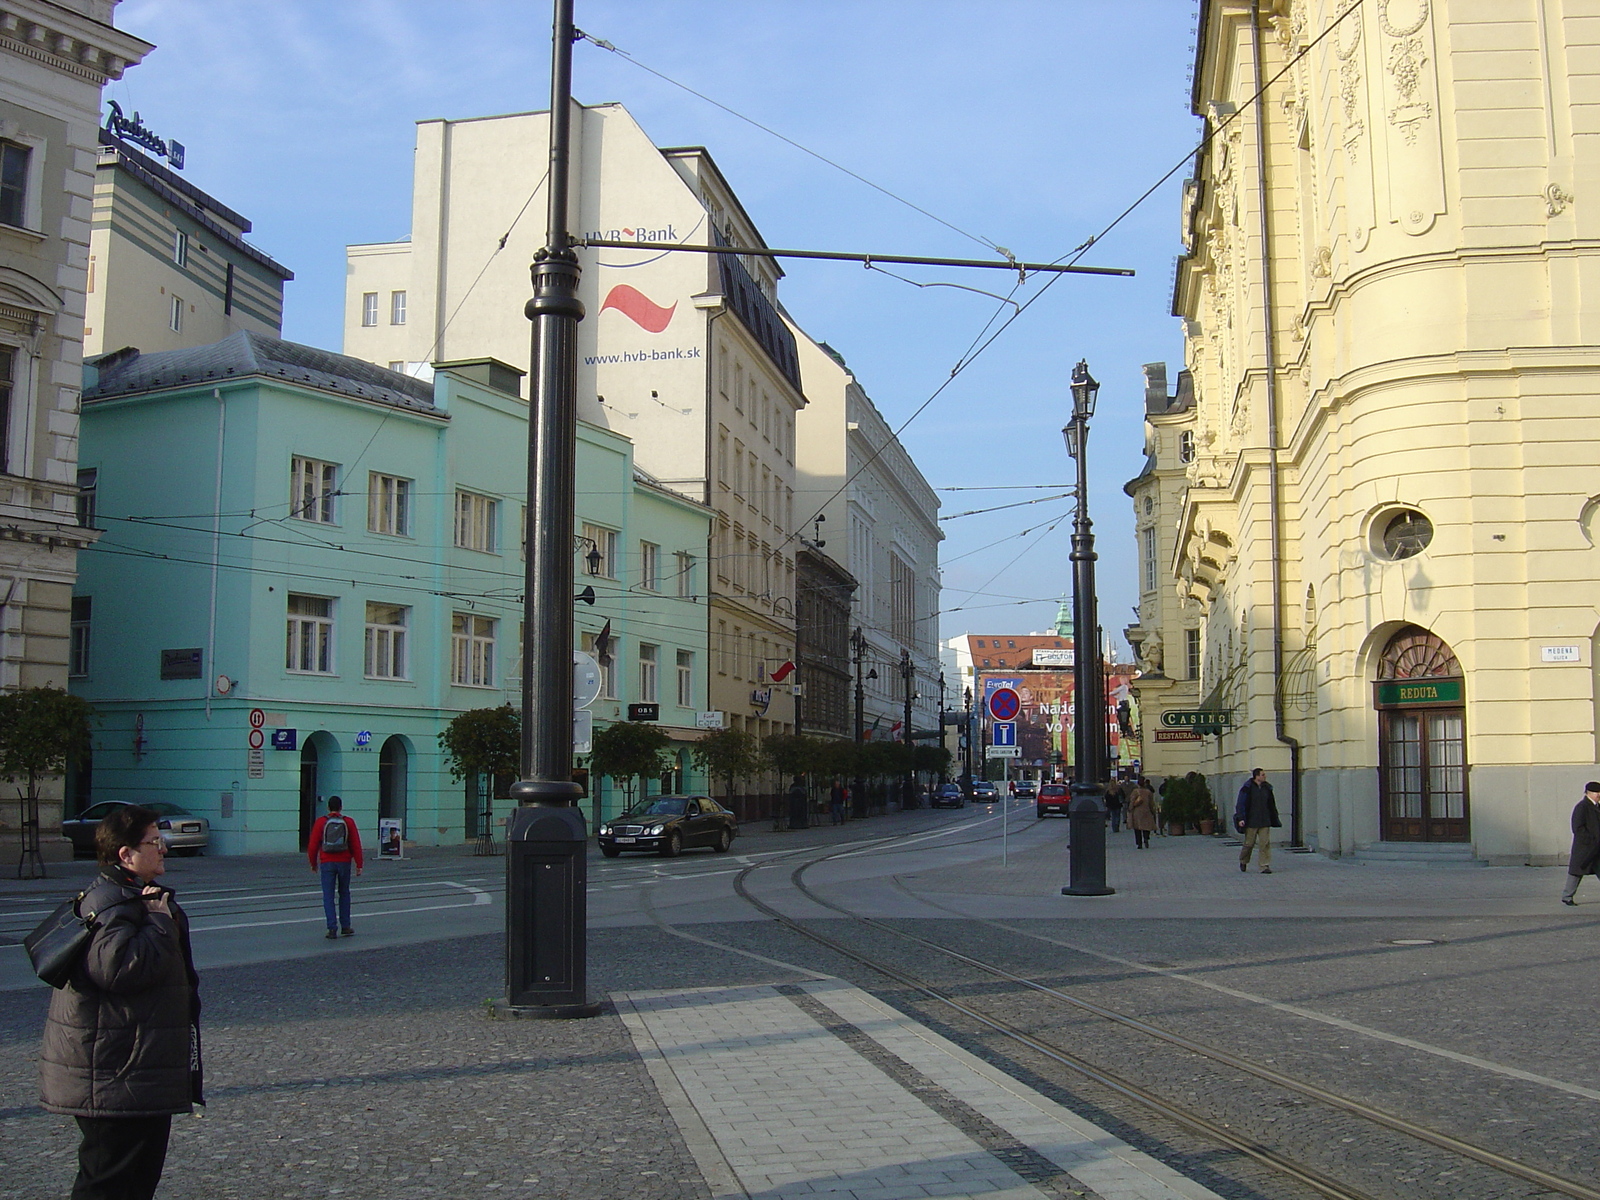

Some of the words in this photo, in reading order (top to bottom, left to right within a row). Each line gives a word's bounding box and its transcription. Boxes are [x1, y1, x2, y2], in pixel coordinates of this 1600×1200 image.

[636, 224, 678, 243] Bank
[584, 347, 700, 365] www.hvb-bank.sk
[1400, 687, 1438, 699] REDUTA
[1168, 713, 1226, 724] CASINO
